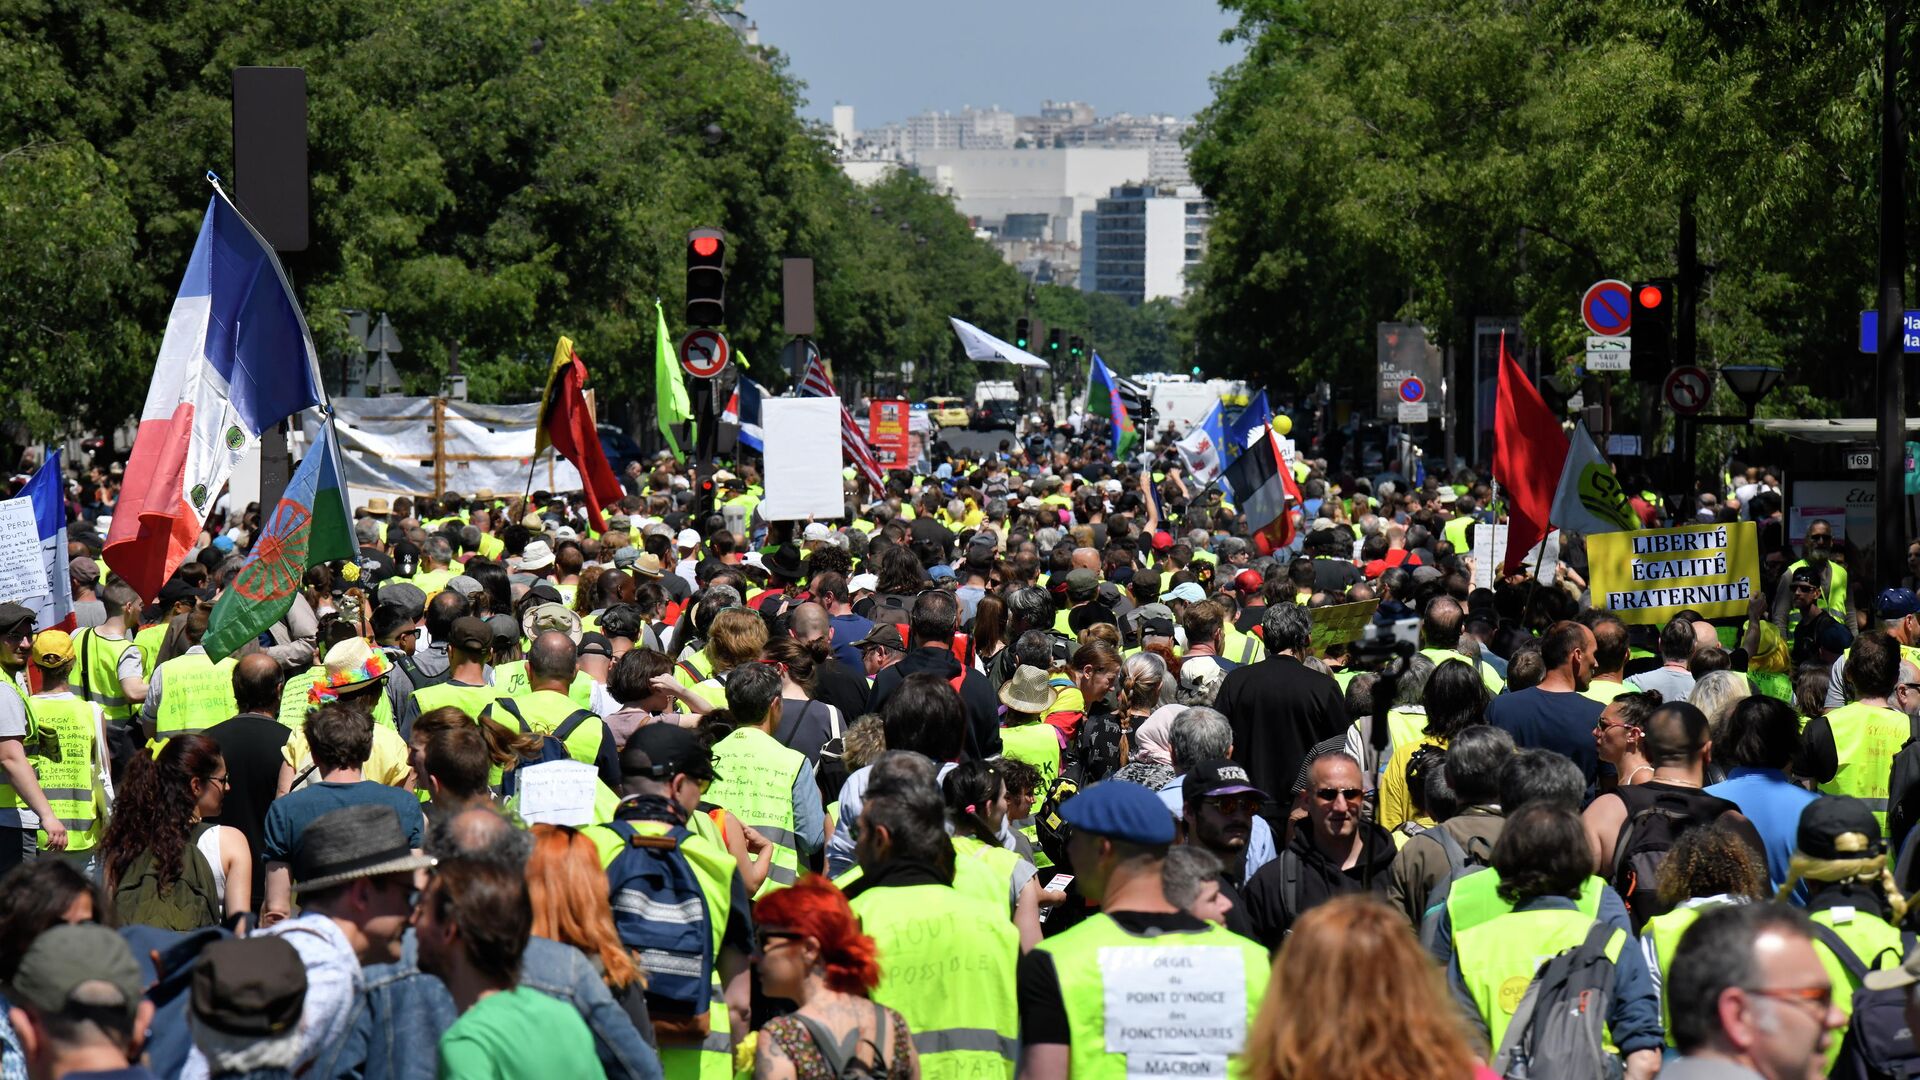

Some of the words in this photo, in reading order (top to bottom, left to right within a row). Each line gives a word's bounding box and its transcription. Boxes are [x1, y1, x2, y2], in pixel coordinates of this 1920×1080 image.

[1851, 455, 1869, 465] 169
[7, 519, 34, 530] PERDU
[0, 531, 27, 541] FOUTU
[1633, 526, 1727, 554] LIBERTÉ
[1632, 552, 1726, 581] ÉGALITÉ
[1609, 578, 1749, 610] FRATERNITÉ
[887, 912, 957, 948] TOUT
[889, 953, 990, 988] POSSIBLE
[1169, 976, 1182, 985] du
[1126, 992, 1165, 1003] POINT
[1171, 991, 1225, 1003] D'INDICE
[1169, 1011, 1186, 1020] des
[1120, 1028, 1233, 1039] FONCTIONNAIRES
[1145, 1061, 1210, 1073] MACRON
